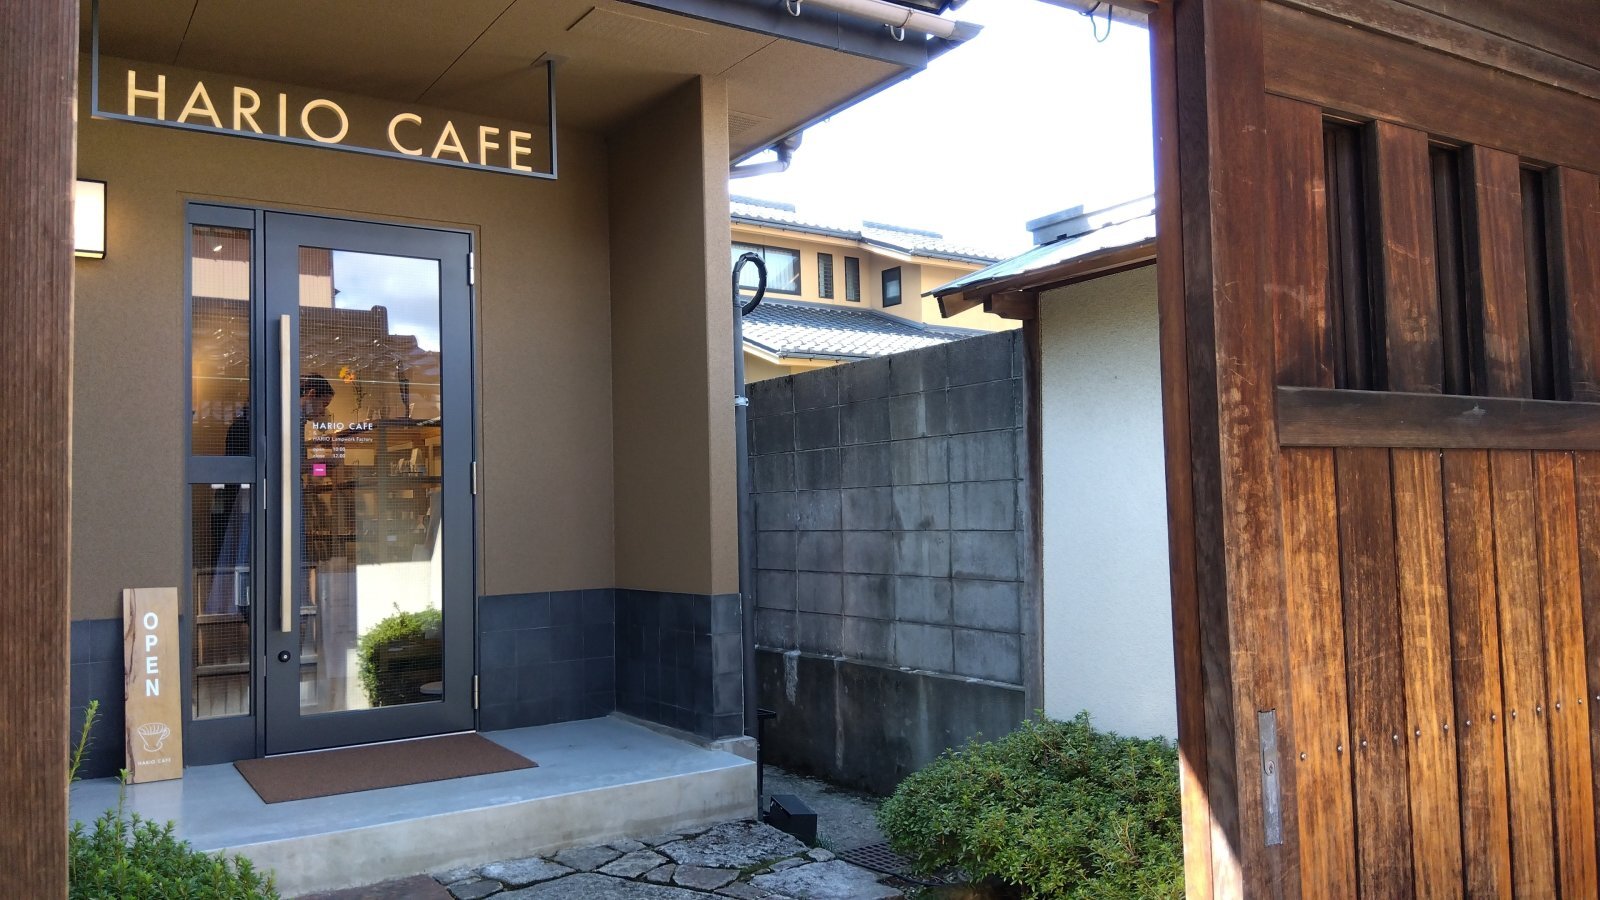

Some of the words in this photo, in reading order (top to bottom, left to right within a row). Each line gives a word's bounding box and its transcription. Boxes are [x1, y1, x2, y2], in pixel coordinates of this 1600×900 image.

[127, 70, 349, 143] HARIO
[388, 112, 532, 172] CAFE
[312, 422, 345, 430] HARIO
[349, 422, 373, 431] CAFE
[143, 612, 160, 697] OPEN
